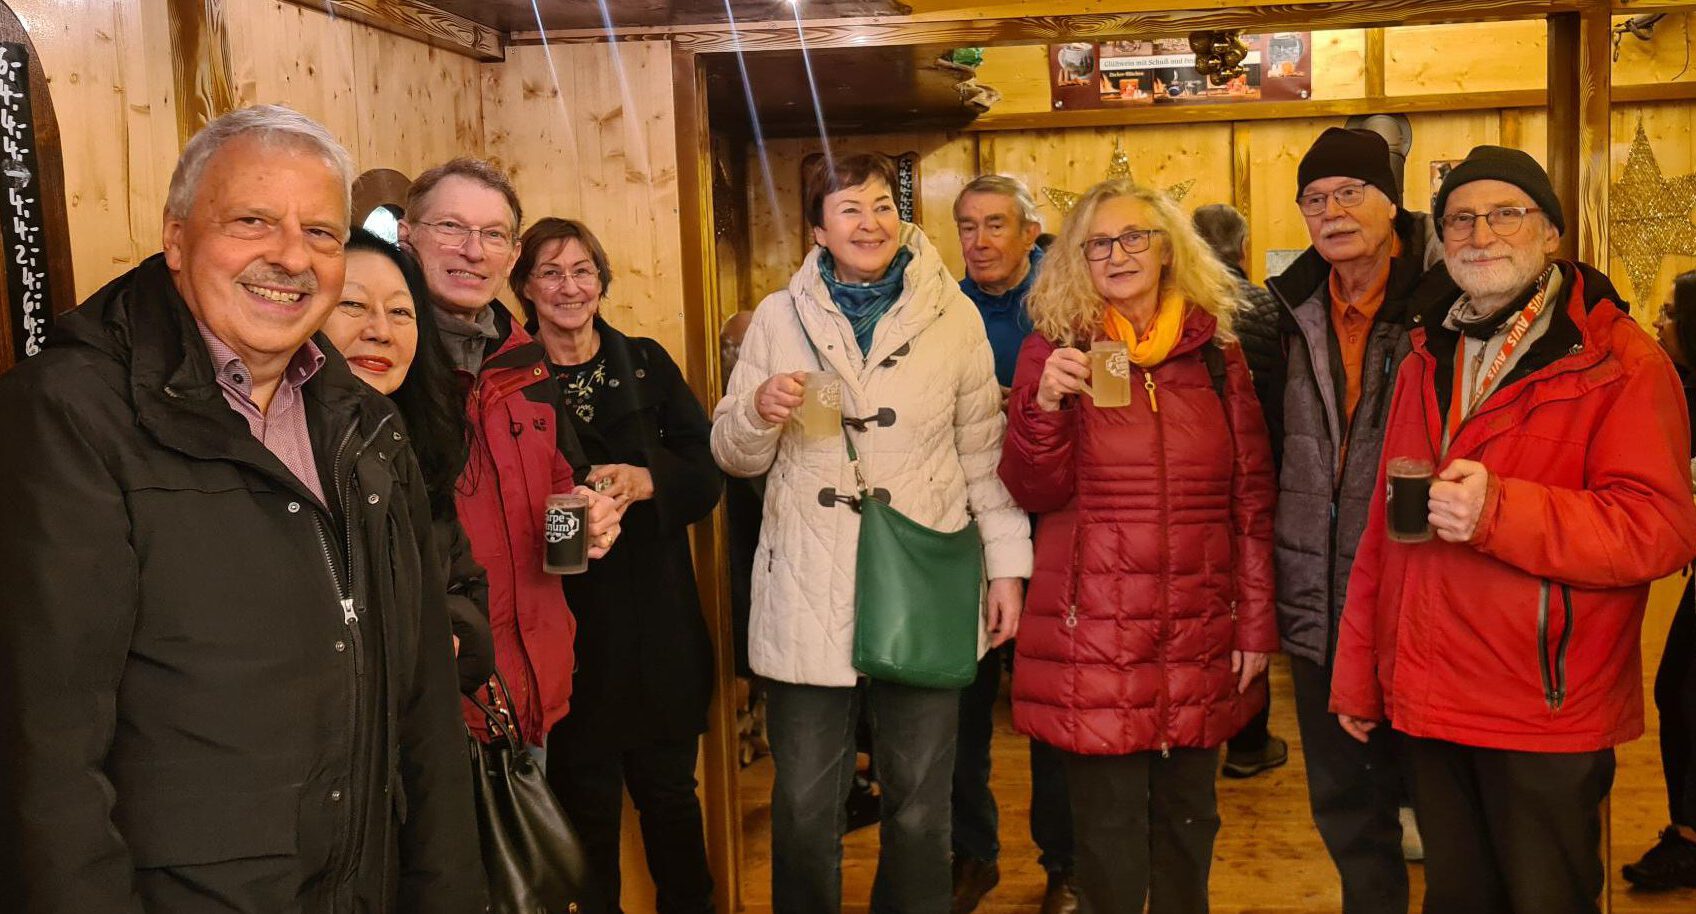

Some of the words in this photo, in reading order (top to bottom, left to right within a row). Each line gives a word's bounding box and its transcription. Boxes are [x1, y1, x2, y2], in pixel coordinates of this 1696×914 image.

[1529, 289, 1546, 314] AVIS
[1507, 315, 1530, 347] AVIS
[1487, 350, 1507, 380] AVIS
[545, 514, 565, 524] arpe
